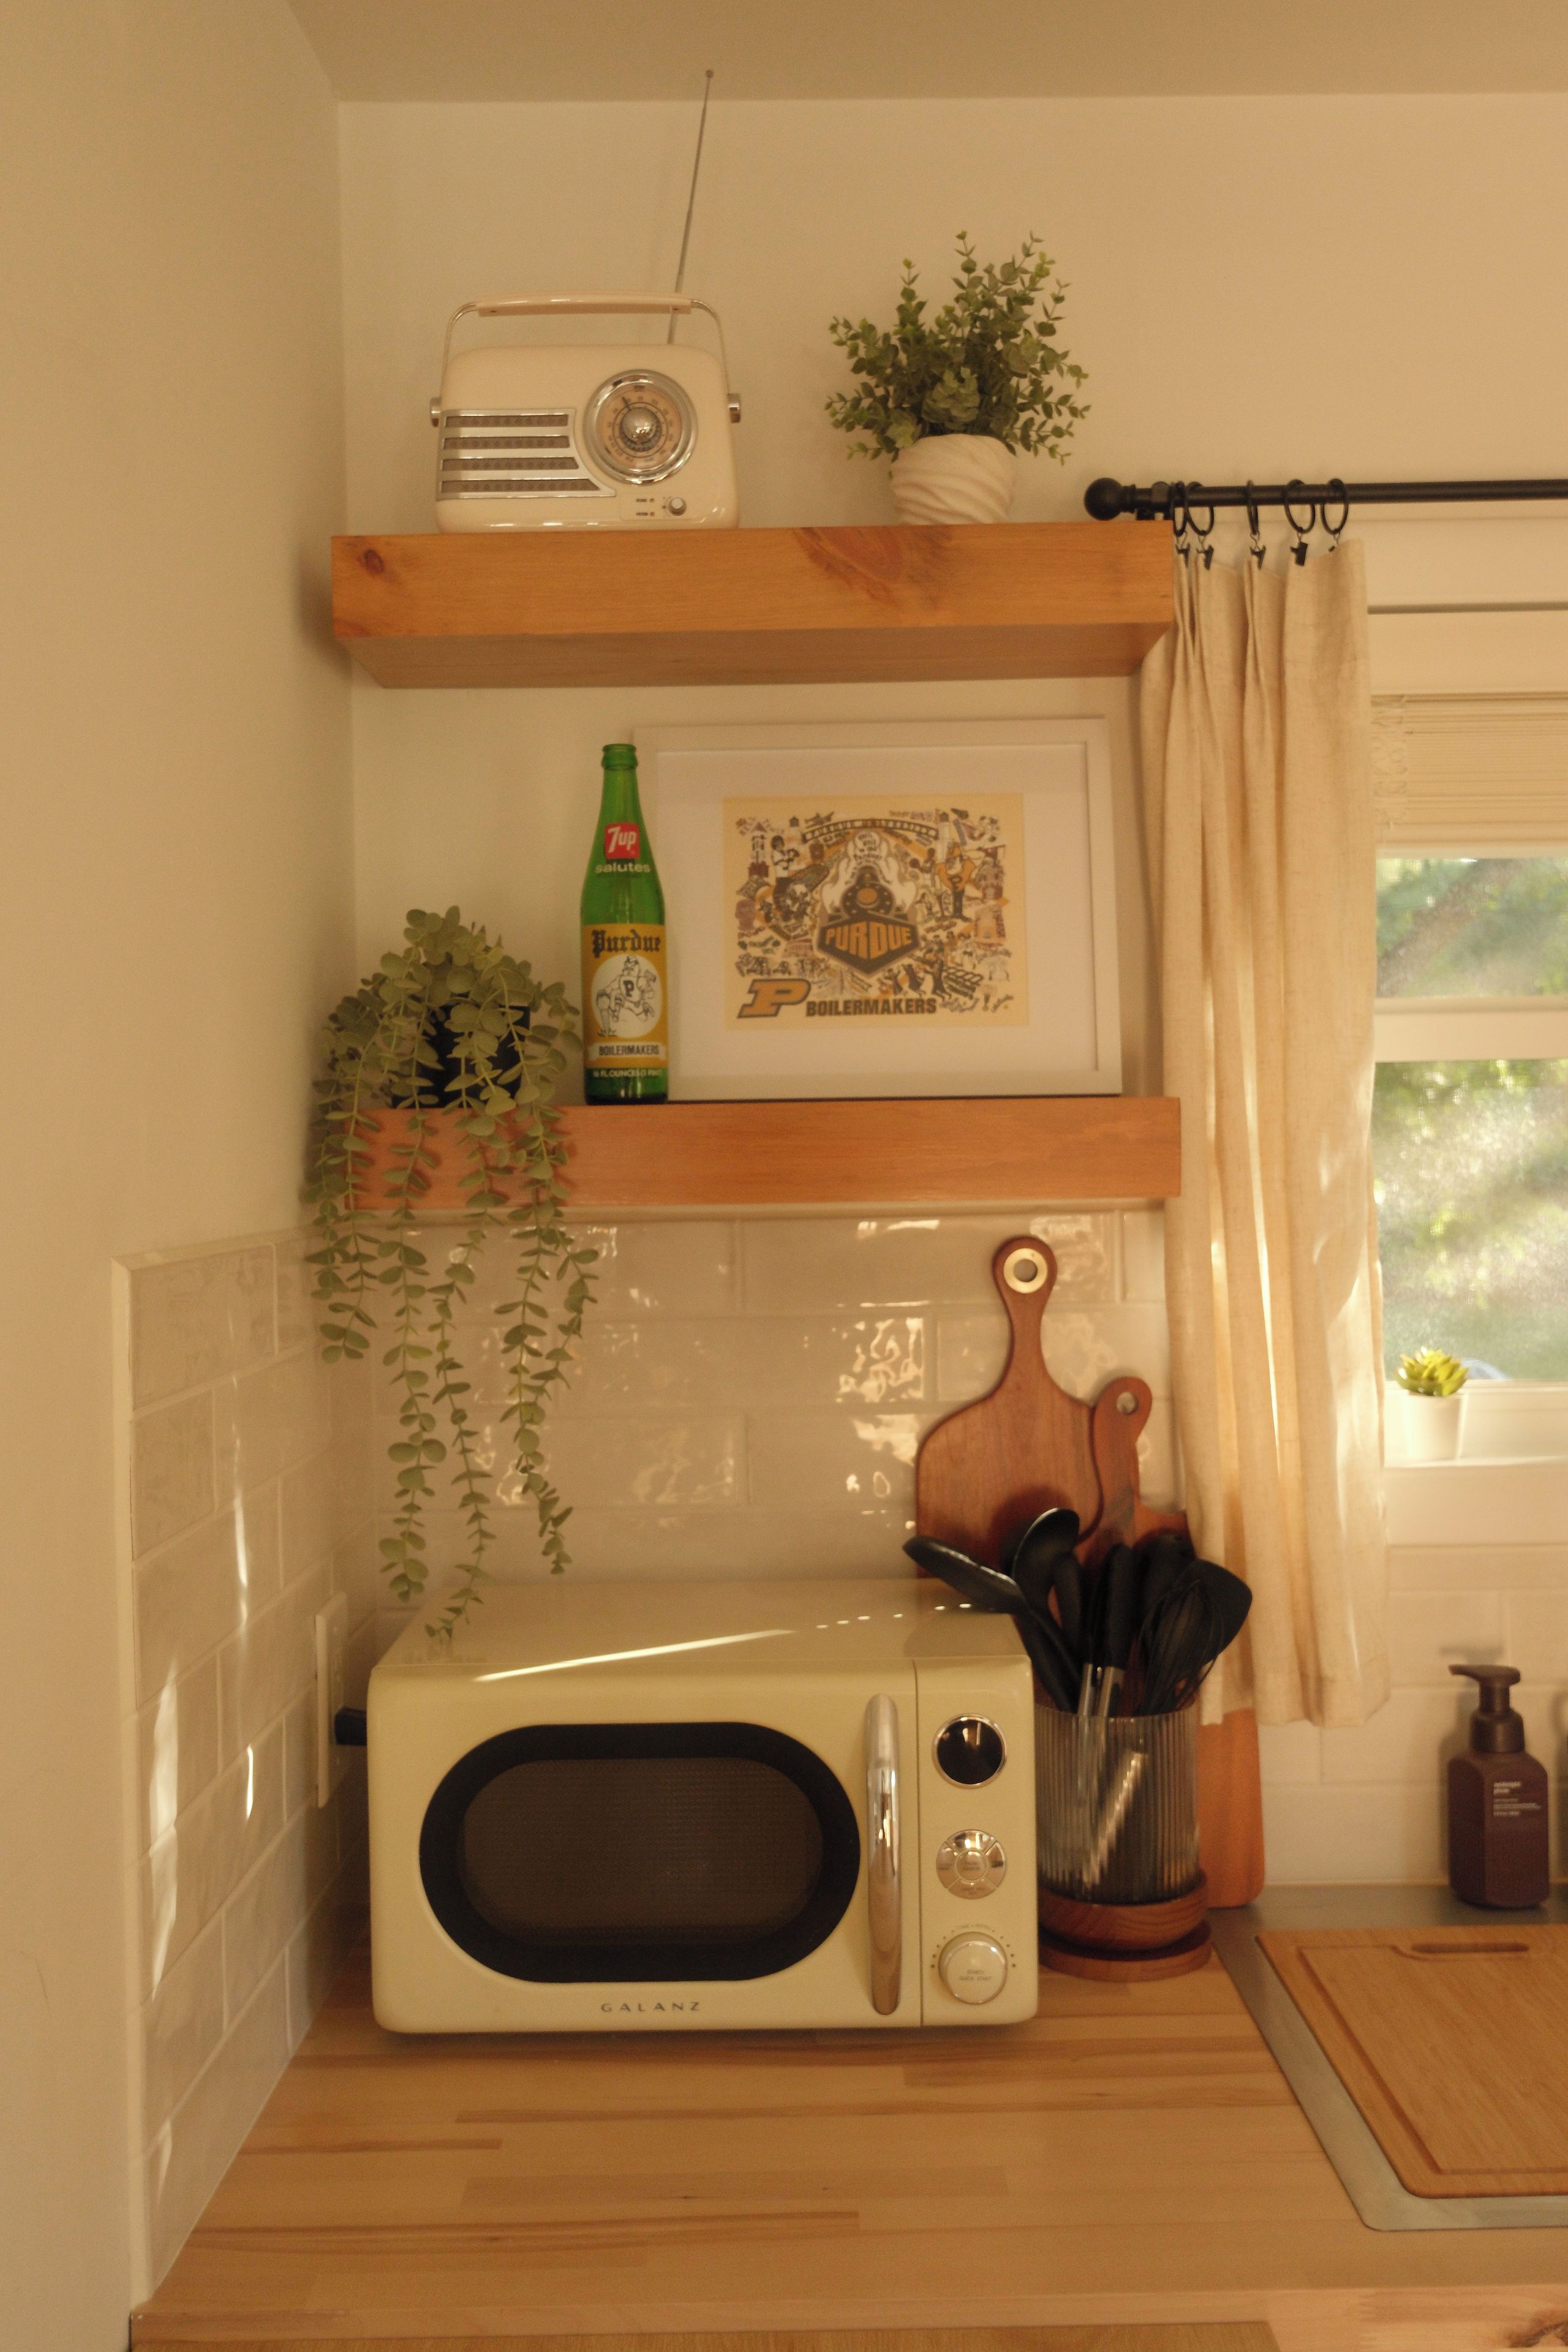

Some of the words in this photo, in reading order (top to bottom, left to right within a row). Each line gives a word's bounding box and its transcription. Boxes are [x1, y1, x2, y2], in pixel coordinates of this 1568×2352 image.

[608, 826, 636, 853] 7up
[595, 862, 651, 873] salutes
[591, 929, 661, 959] Purdue
[824, 921, 912, 960] PURDUE
[624, 980, 635, 997] P
[805, 997, 937, 1017] BOILERMAKERS
[598, 1044, 660, 1056] BOILERMAKERS
[600, 2001, 700, 2012] GALANZ
